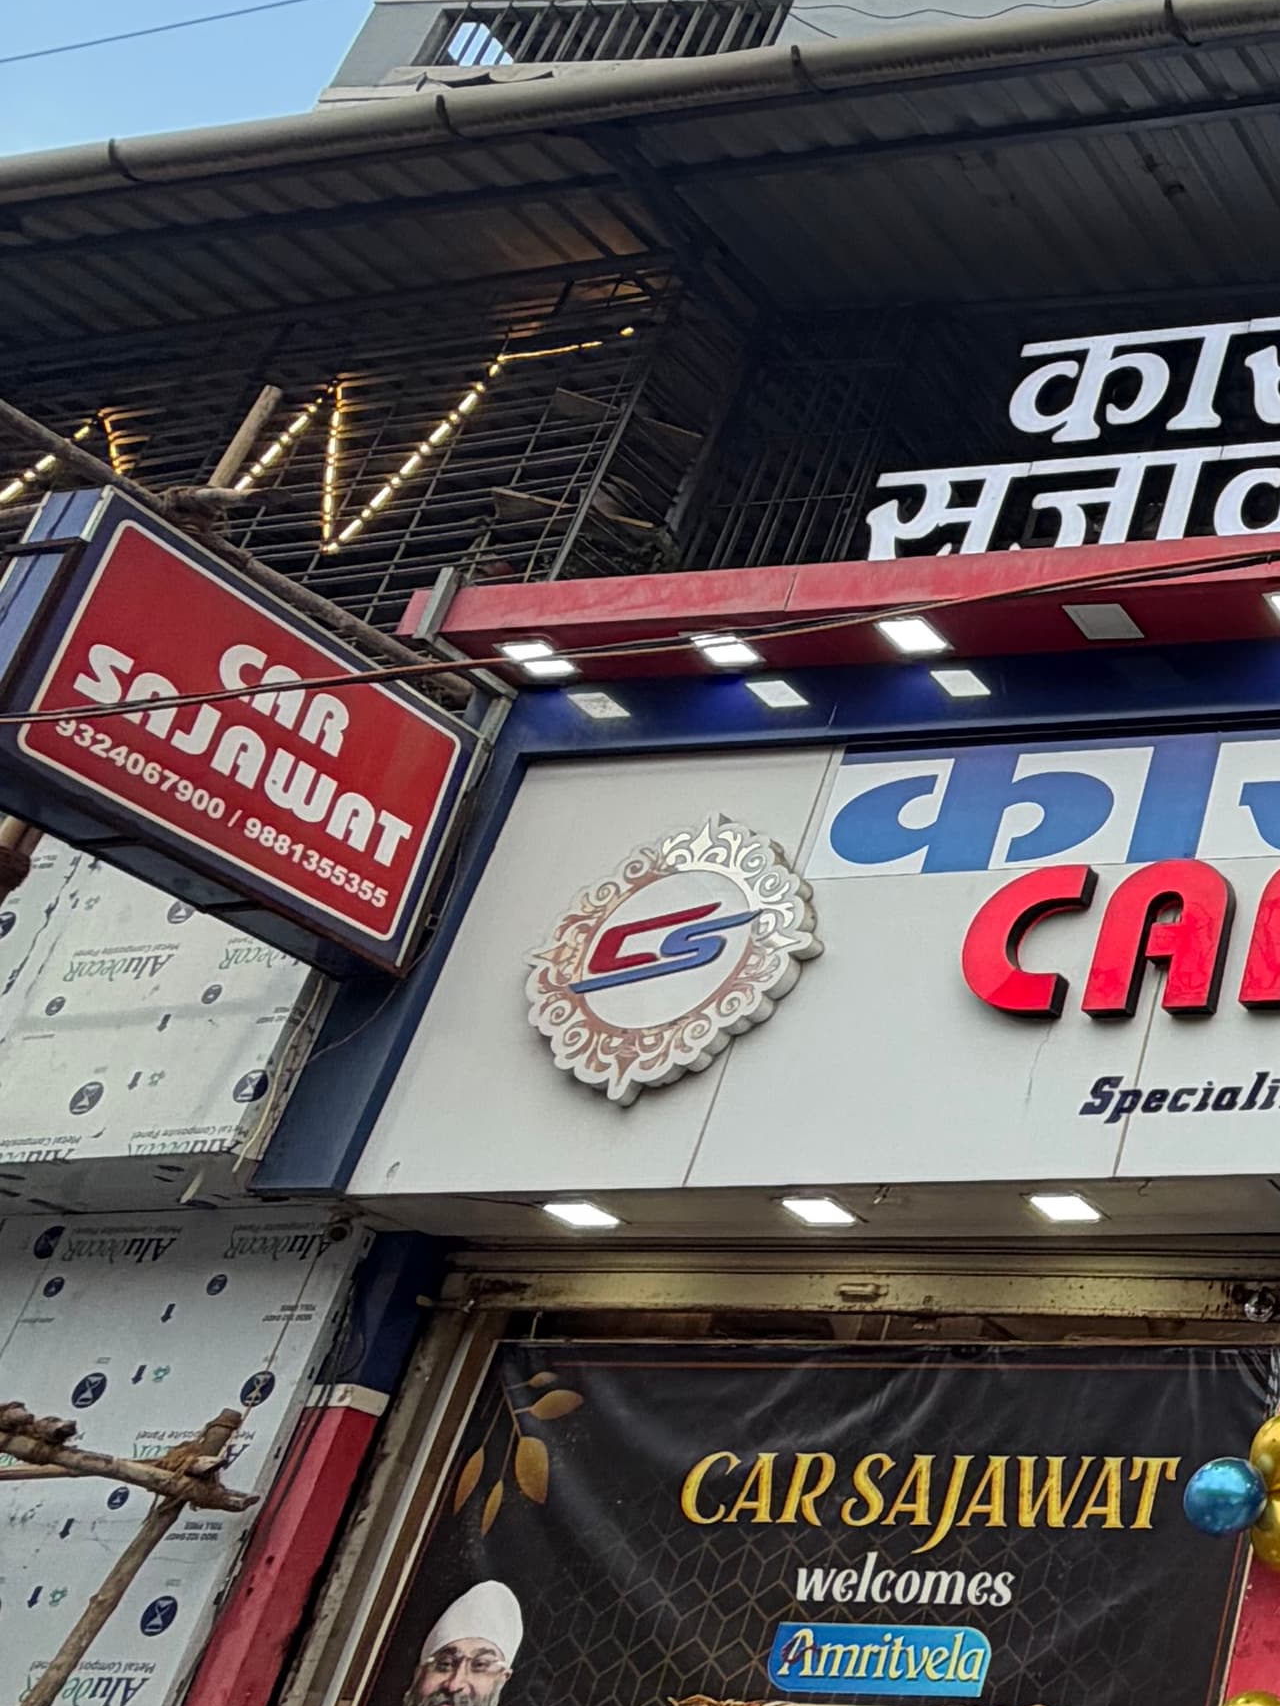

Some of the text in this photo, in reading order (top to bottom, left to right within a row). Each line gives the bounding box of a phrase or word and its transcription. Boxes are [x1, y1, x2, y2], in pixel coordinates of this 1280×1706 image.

[219, 644, 349, 757] CAR
[73, 644, 412, 868] SAJAWAT
[55, 718, 225, 819] 9324067900
[244, 817, 389, 908] 9881355355
[680, 1452, 1181, 1553] CAR SAJAWAT
[795, 1551, 1015, 1608] welcomes
[777, 1627, 988, 1685] Amritvela
